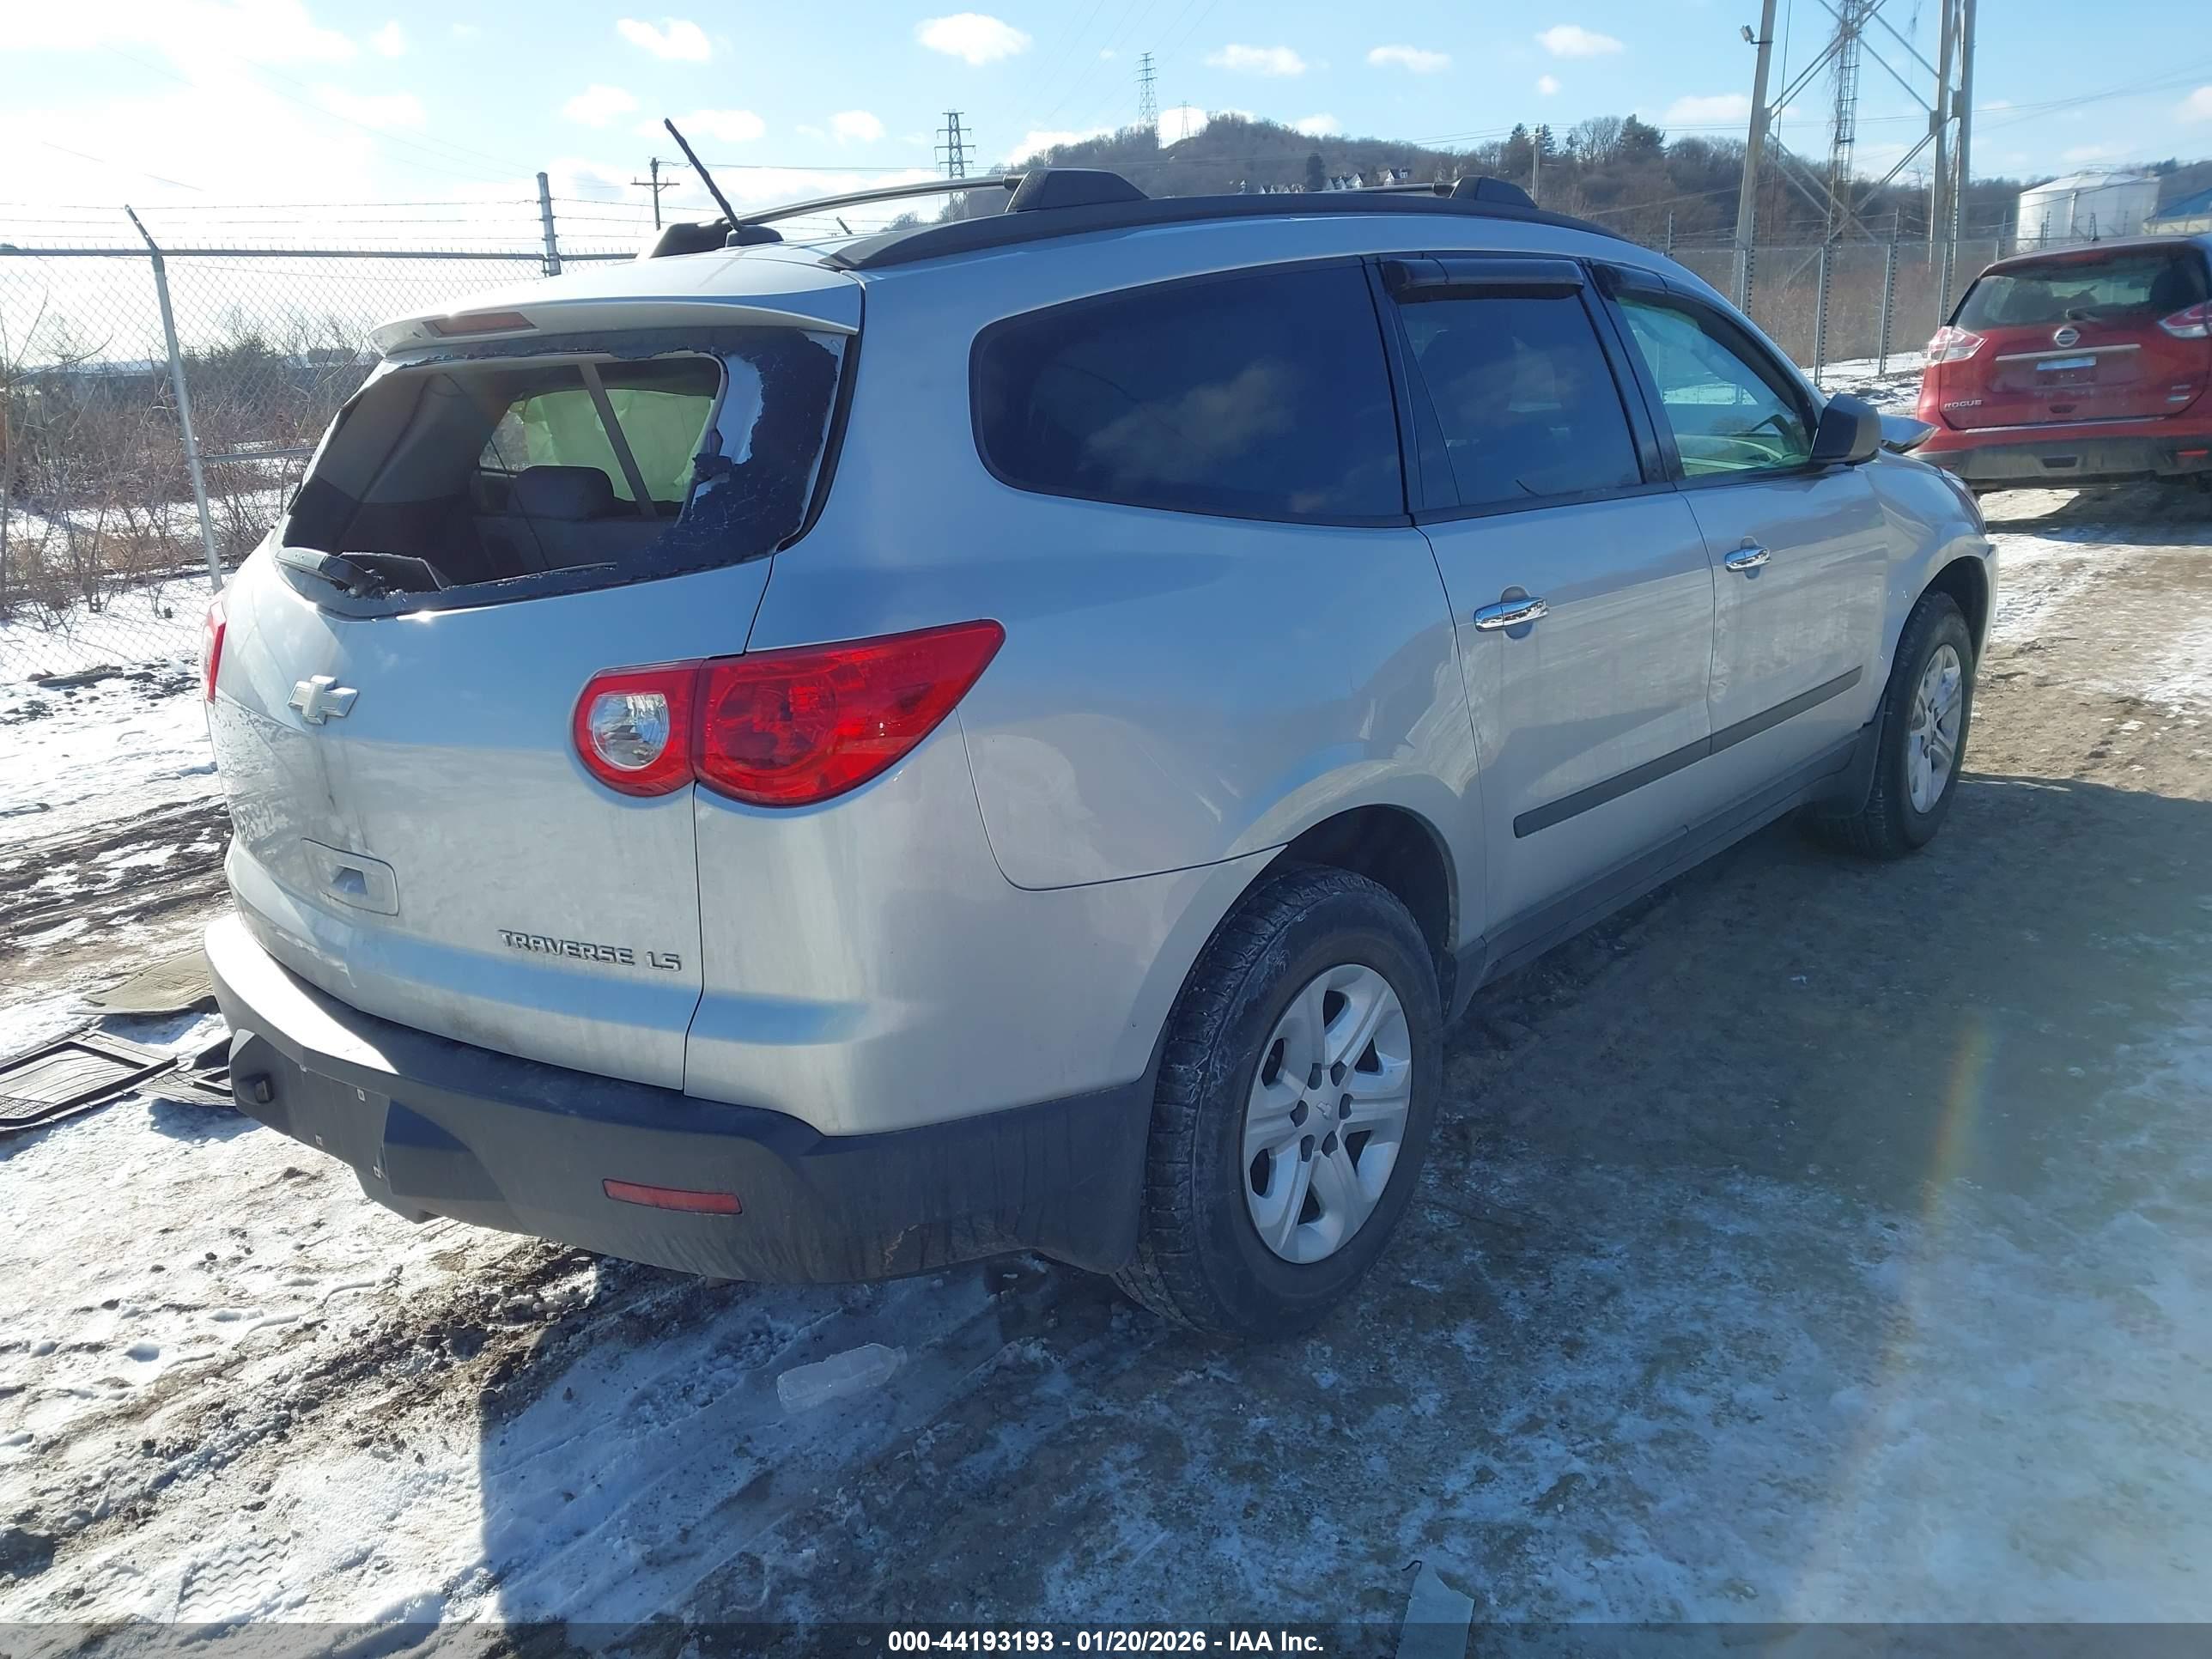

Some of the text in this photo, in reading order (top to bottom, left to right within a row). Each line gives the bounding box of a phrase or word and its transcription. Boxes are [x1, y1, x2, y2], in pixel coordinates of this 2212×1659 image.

[1944, 399, 1983, 409] ROGUE
[498, 929, 681, 972] TRAVERSE LS
